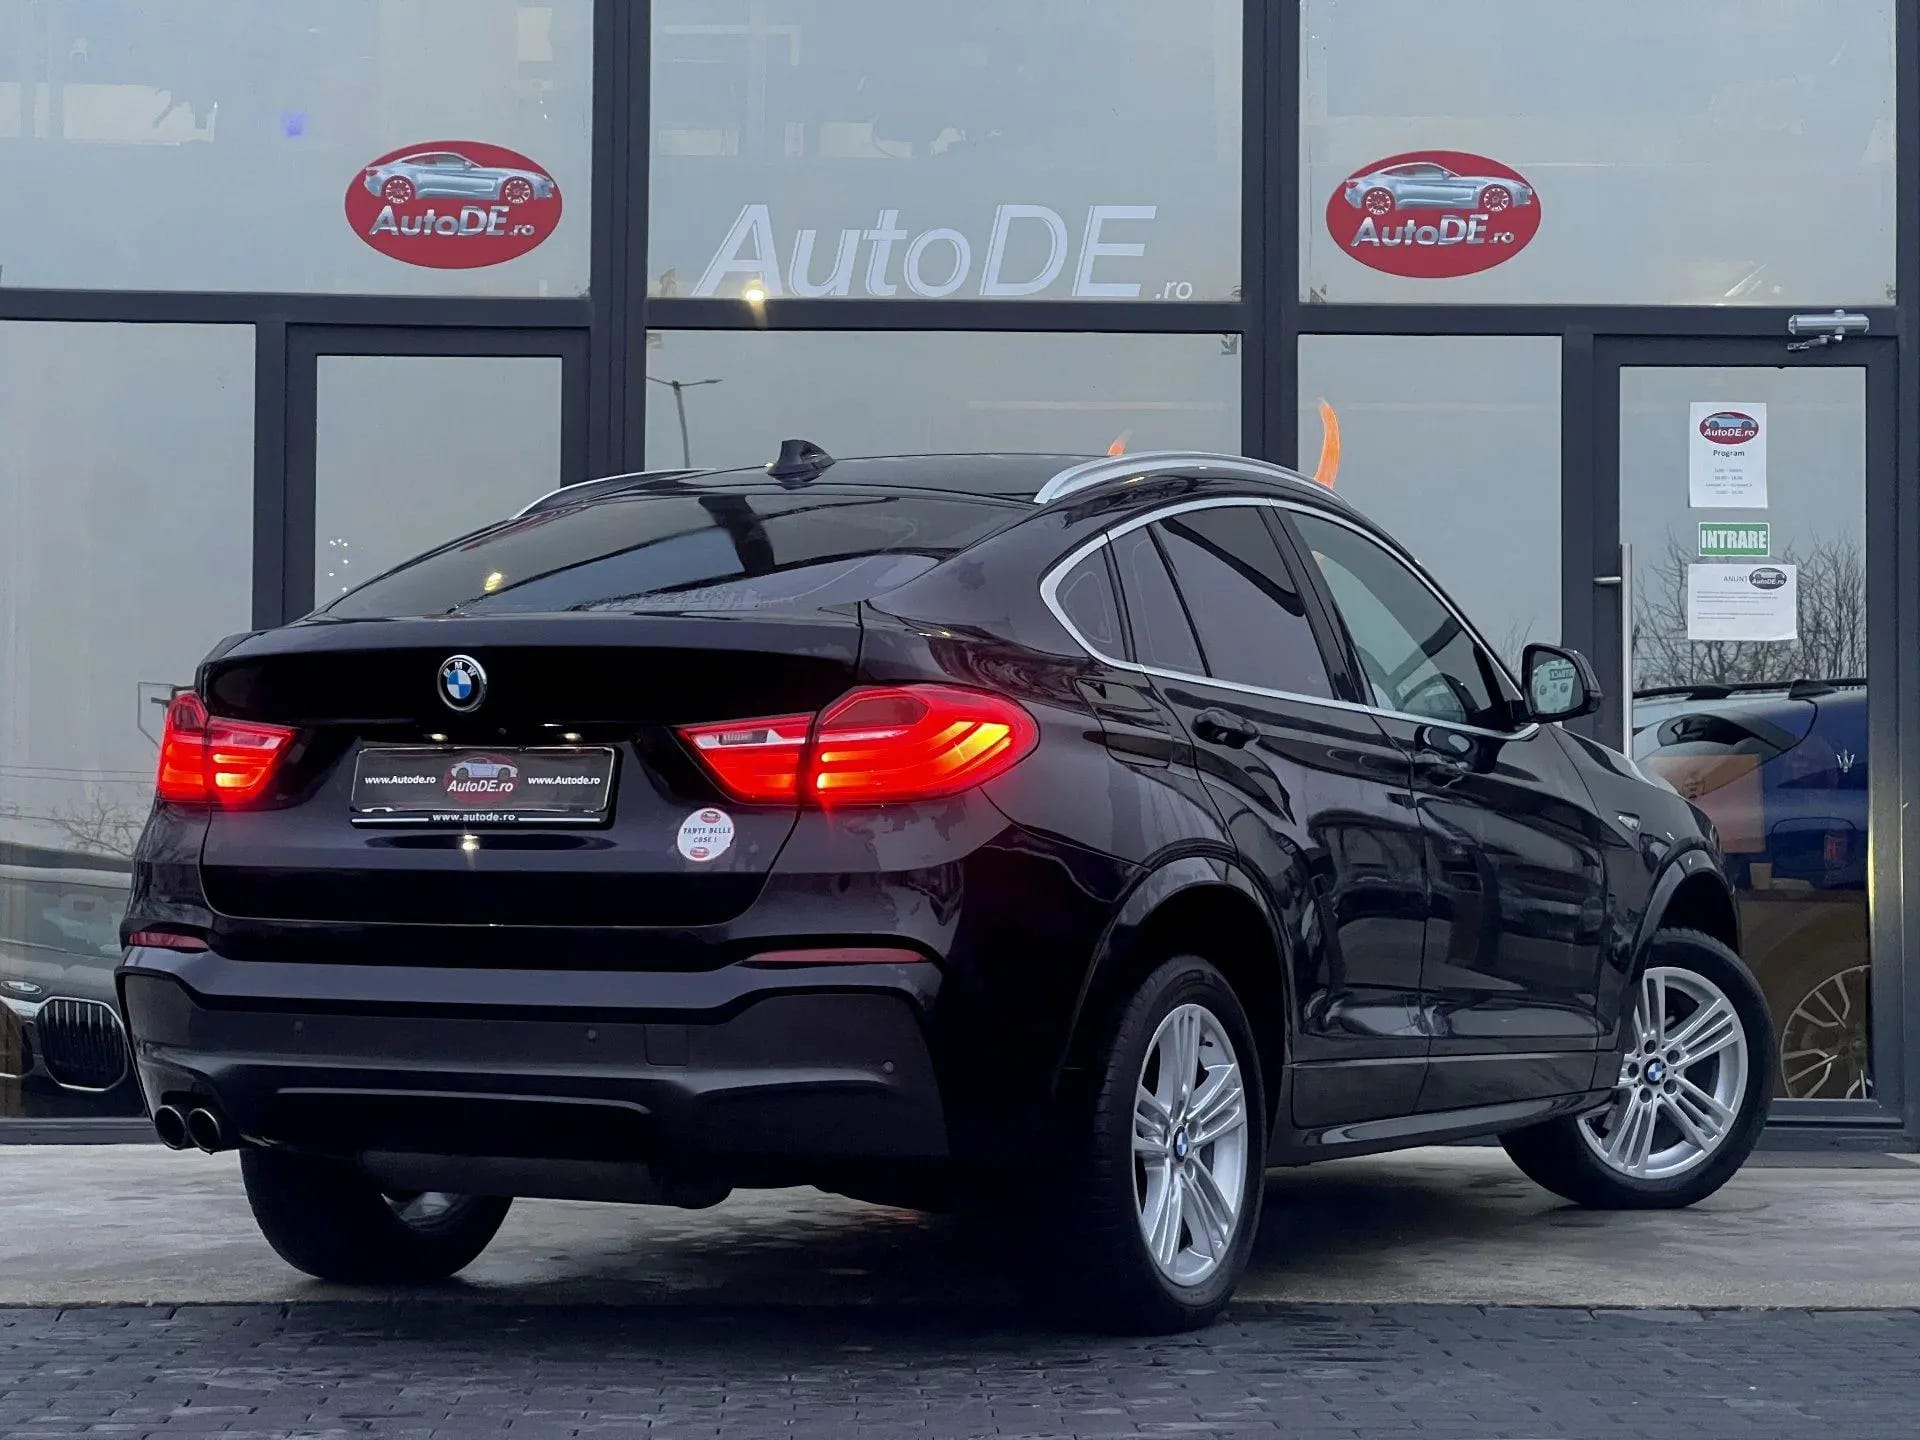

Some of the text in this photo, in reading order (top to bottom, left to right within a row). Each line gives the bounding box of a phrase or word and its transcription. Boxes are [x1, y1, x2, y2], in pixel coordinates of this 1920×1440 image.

[1703, 428, 1755, 437] AutoDE.ro
[1713, 449, 1745, 458] Program
[1701, 530, 1767, 549] INTRARE
[443, 661, 478, 677] BMW
[364, 775, 437, 784] www.Autode.ro
[527, 776, 601, 785] www.Autode.ro
[447, 779, 514, 792] AutoDE.ro
[432, 812, 516, 822] www.autode.ro
